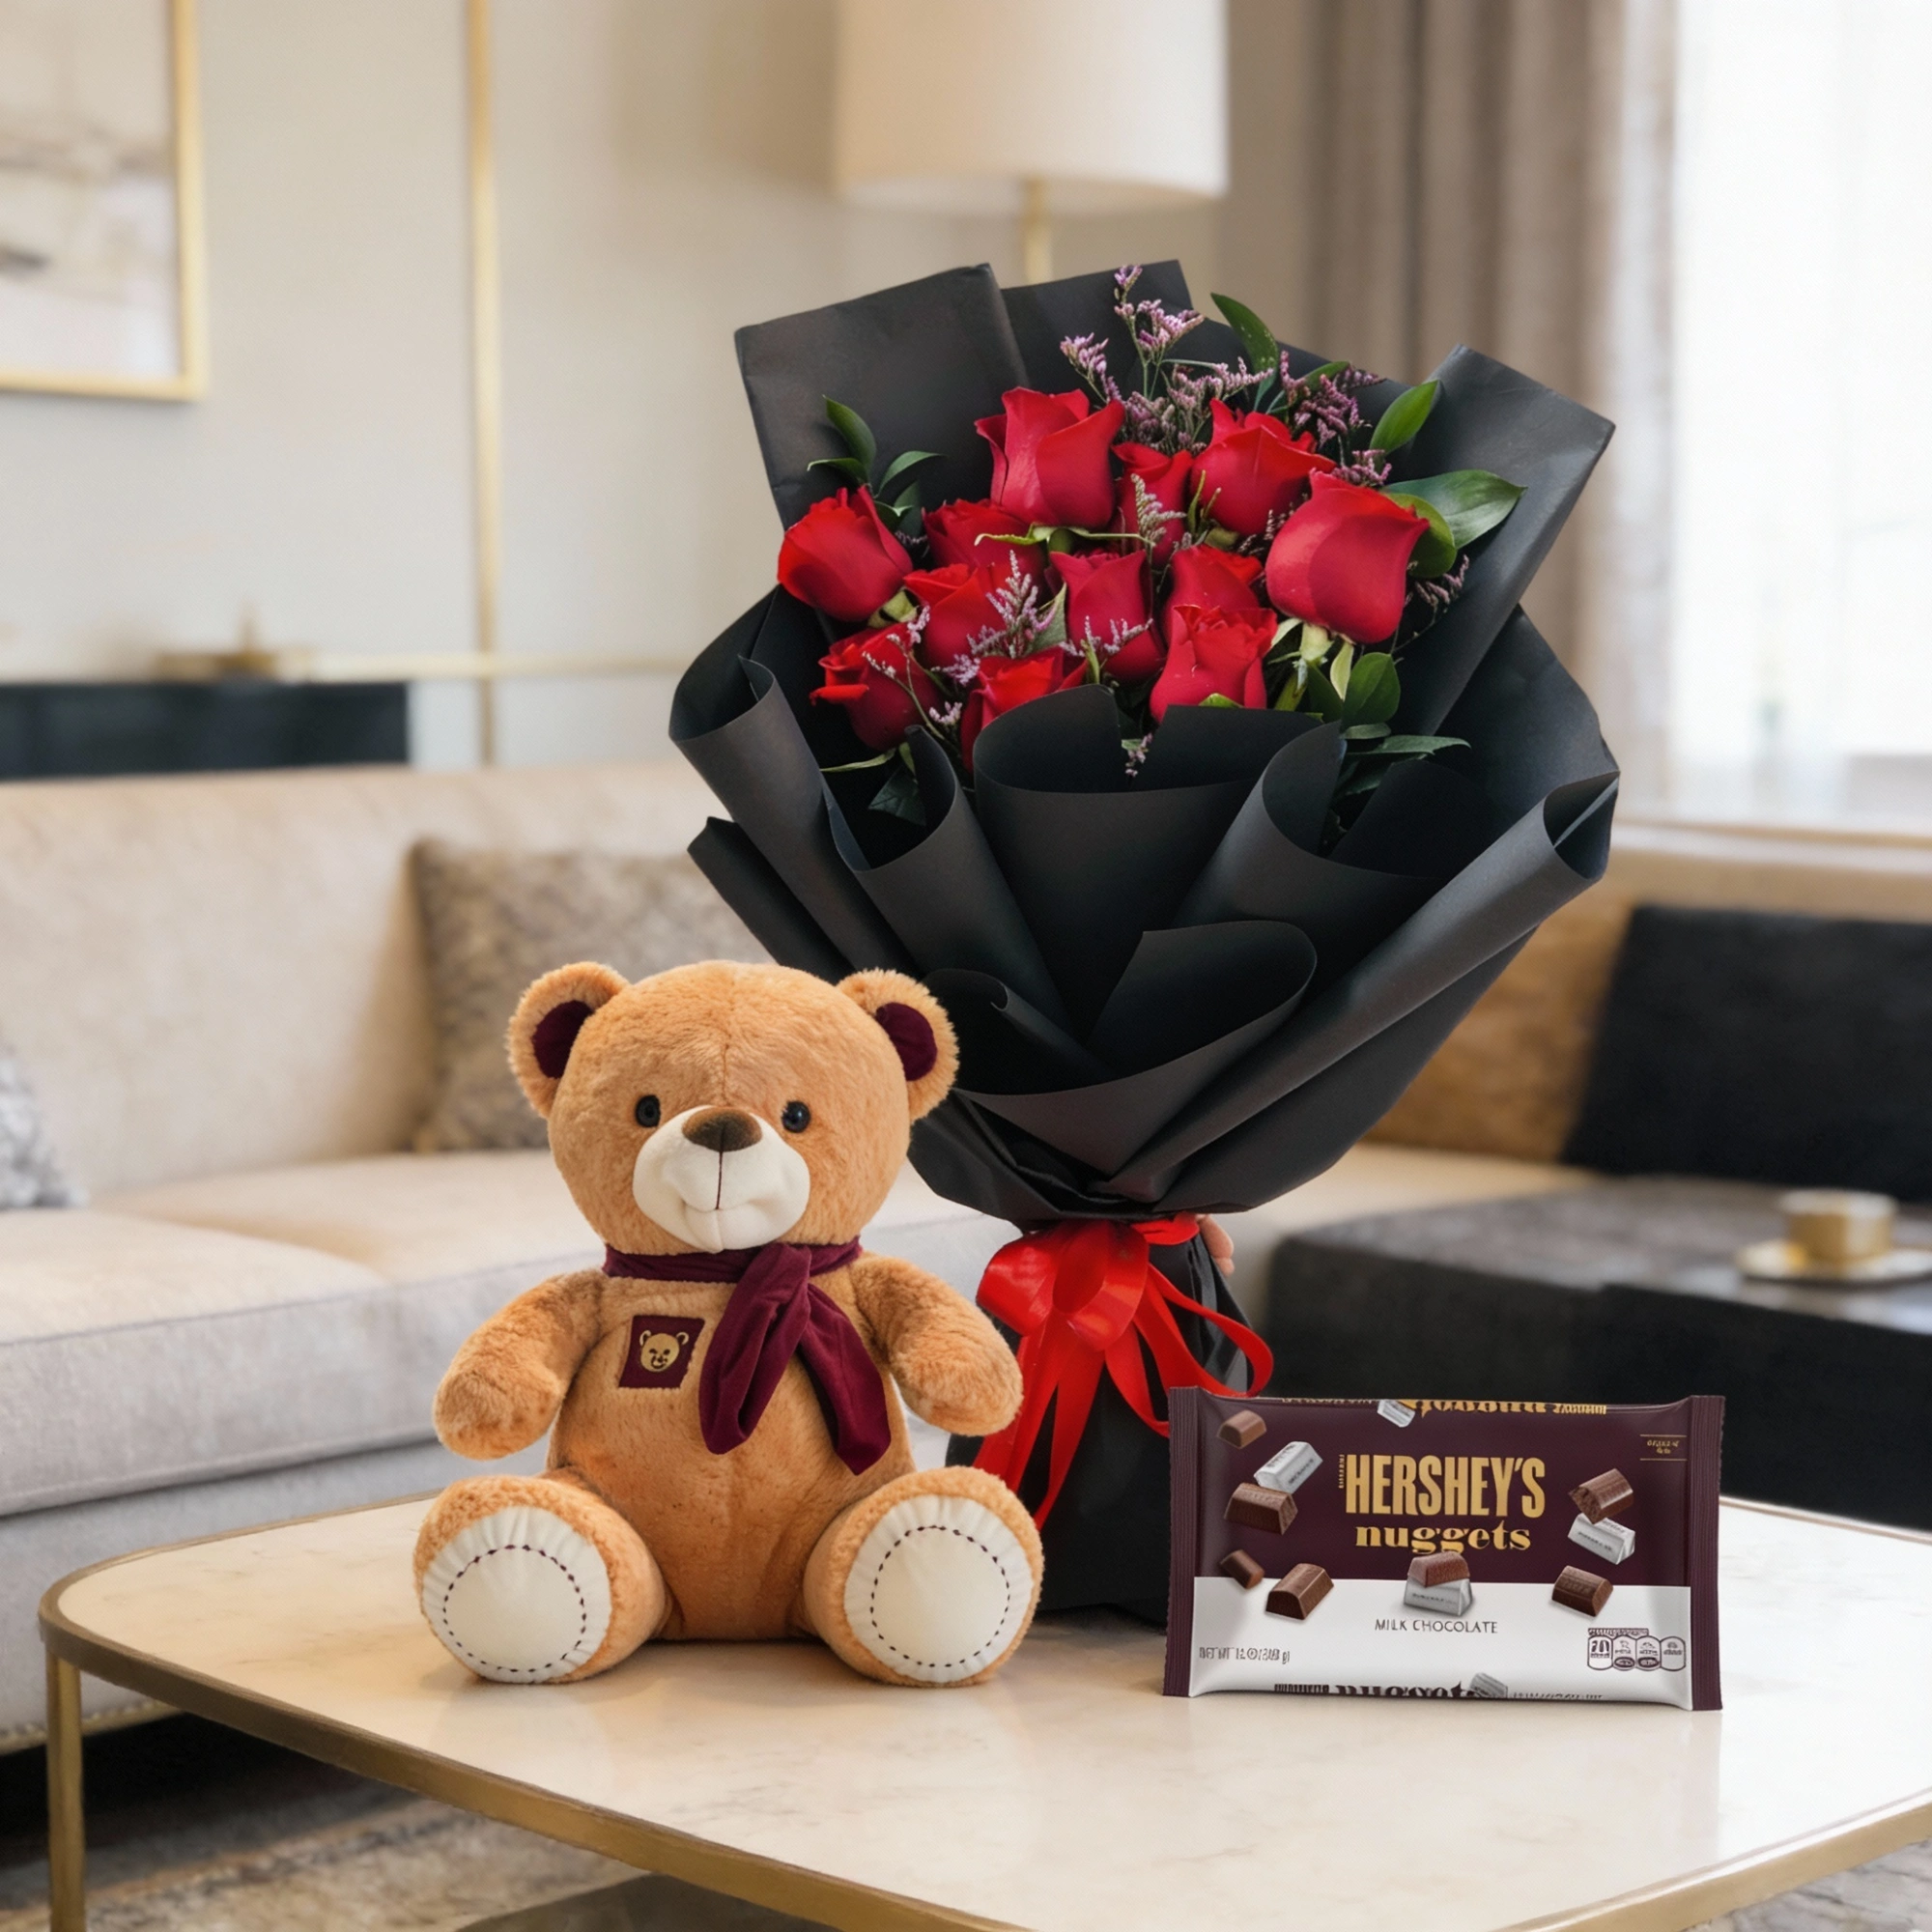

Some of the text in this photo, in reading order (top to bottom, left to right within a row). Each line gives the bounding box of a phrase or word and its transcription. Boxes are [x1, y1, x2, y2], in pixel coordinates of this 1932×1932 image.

[1346, 1454, 1546, 1519] HERSHEY'S
[1355, 1520, 1531, 1555] nuggets
[1375, 1618, 1498, 1634] MILK CHOCOLATE
